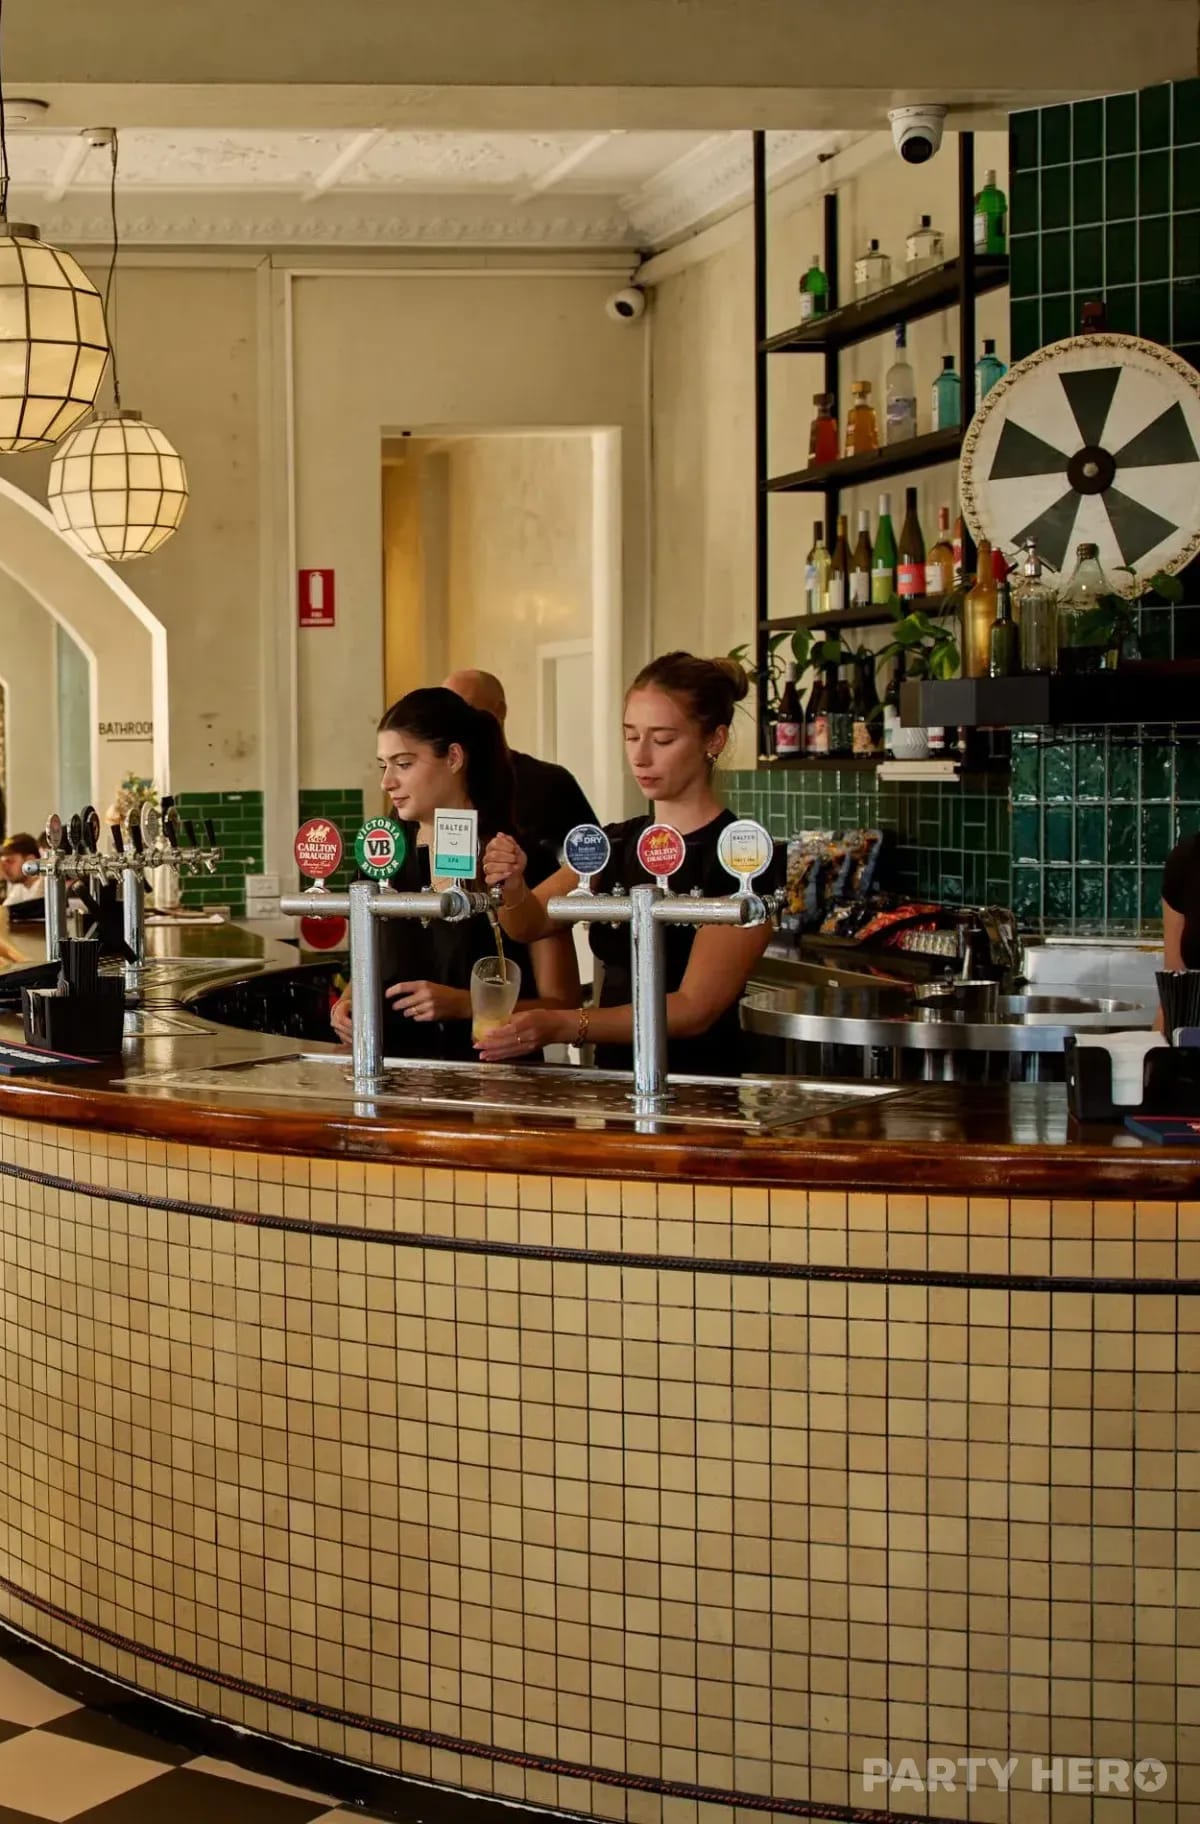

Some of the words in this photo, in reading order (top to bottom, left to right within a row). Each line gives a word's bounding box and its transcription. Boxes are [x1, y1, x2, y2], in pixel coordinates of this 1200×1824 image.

[98, 721, 154, 735] BATHROO
[356, 818, 400, 841] VICTORIA
[583, 835, 603, 844] DRY
[297, 842, 337, 853] CARLTON
[367, 839, 391, 856] VB
[644, 847, 678, 857] CARLTON
[299, 851, 336, 861] DRAUGHT
[646, 854, 677, 863] DRAUGHT
[360, 860, 400, 877] BITTER
